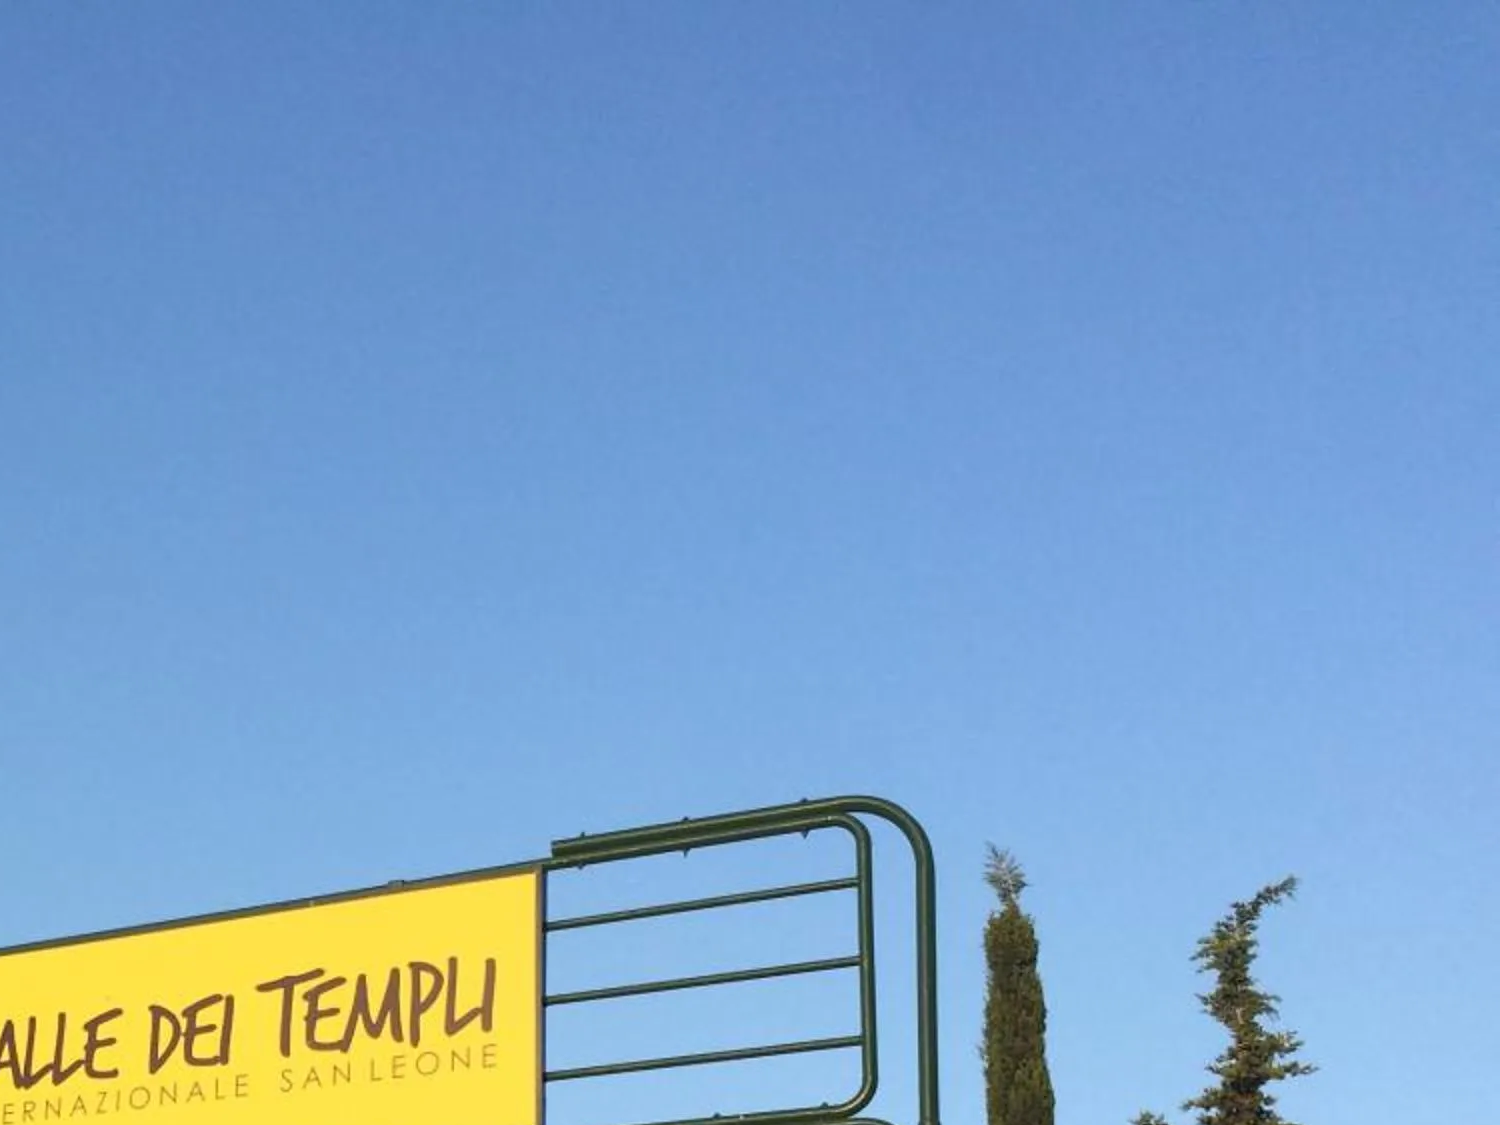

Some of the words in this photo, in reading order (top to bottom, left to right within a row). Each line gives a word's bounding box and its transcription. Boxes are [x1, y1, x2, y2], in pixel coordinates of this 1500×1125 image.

[148, 994, 234, 1075] DEI
[256, 957, 497, 1058] TEMPLI
[280, 1064, 353, 1094] SAN
[371, 1043, 499, 1084] LEONE
